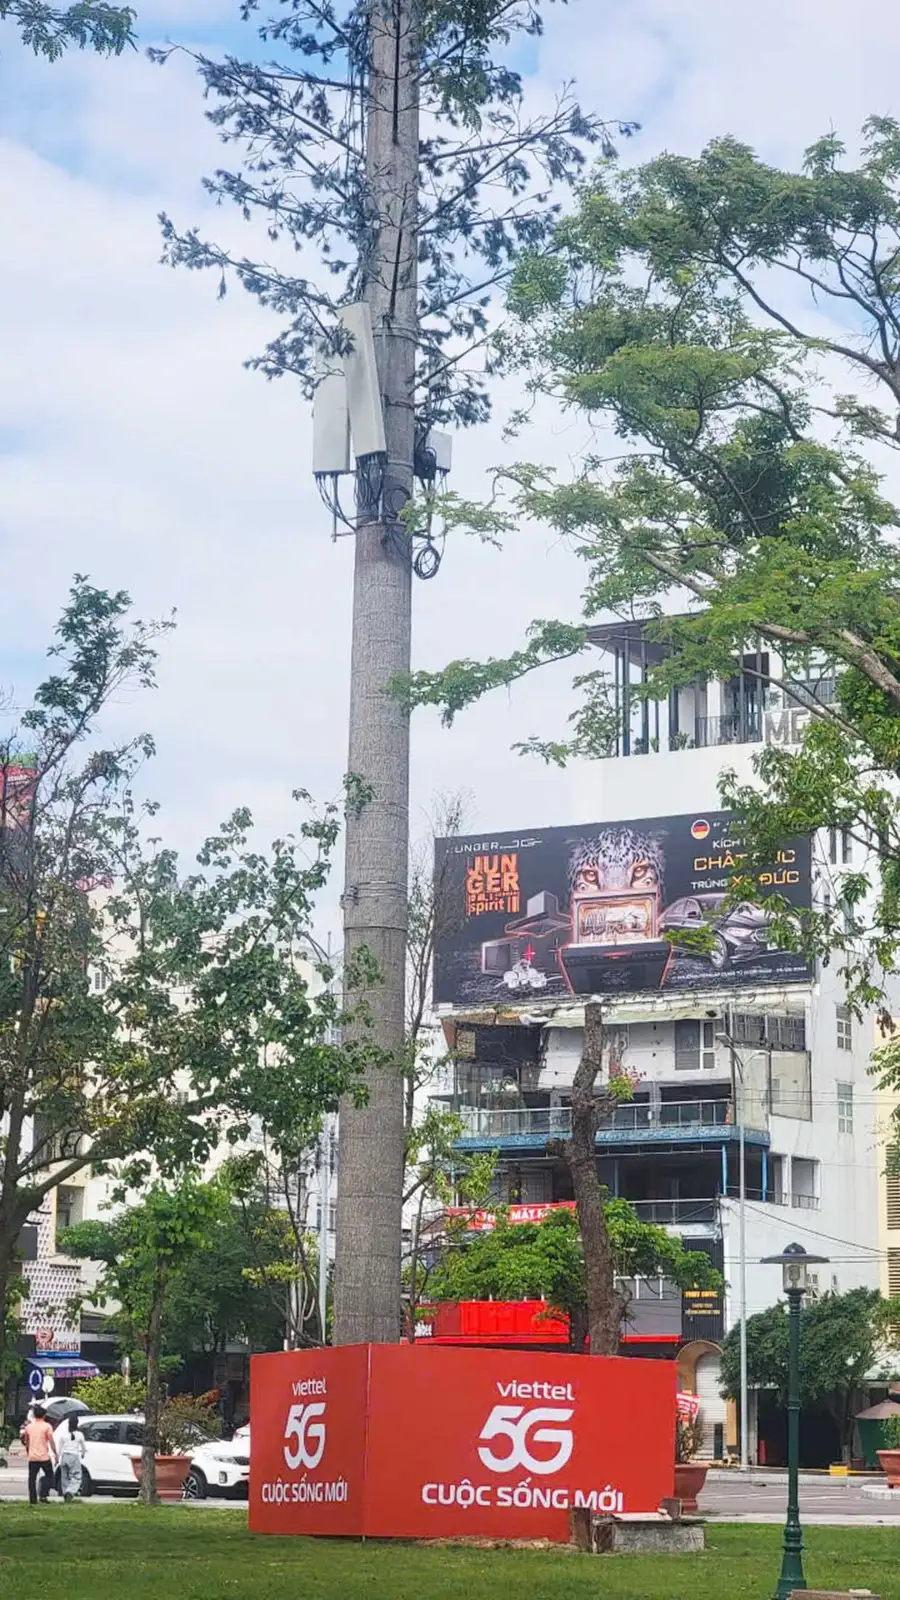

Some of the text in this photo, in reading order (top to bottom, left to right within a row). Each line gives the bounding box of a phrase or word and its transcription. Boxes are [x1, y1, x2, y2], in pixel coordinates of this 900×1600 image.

[292, 1378, 327, 1396] viettel
[497, 1380, 575, 1400] viettel
[283, 1402, 326, 1470] 5G
[477, 1405, 575, 1475] 5G
[261, 1473, 348, 1505] CUỘC SỐNG MỚI
[421, 1476, 624, 1512] CUỘC SỐNG MỚI
